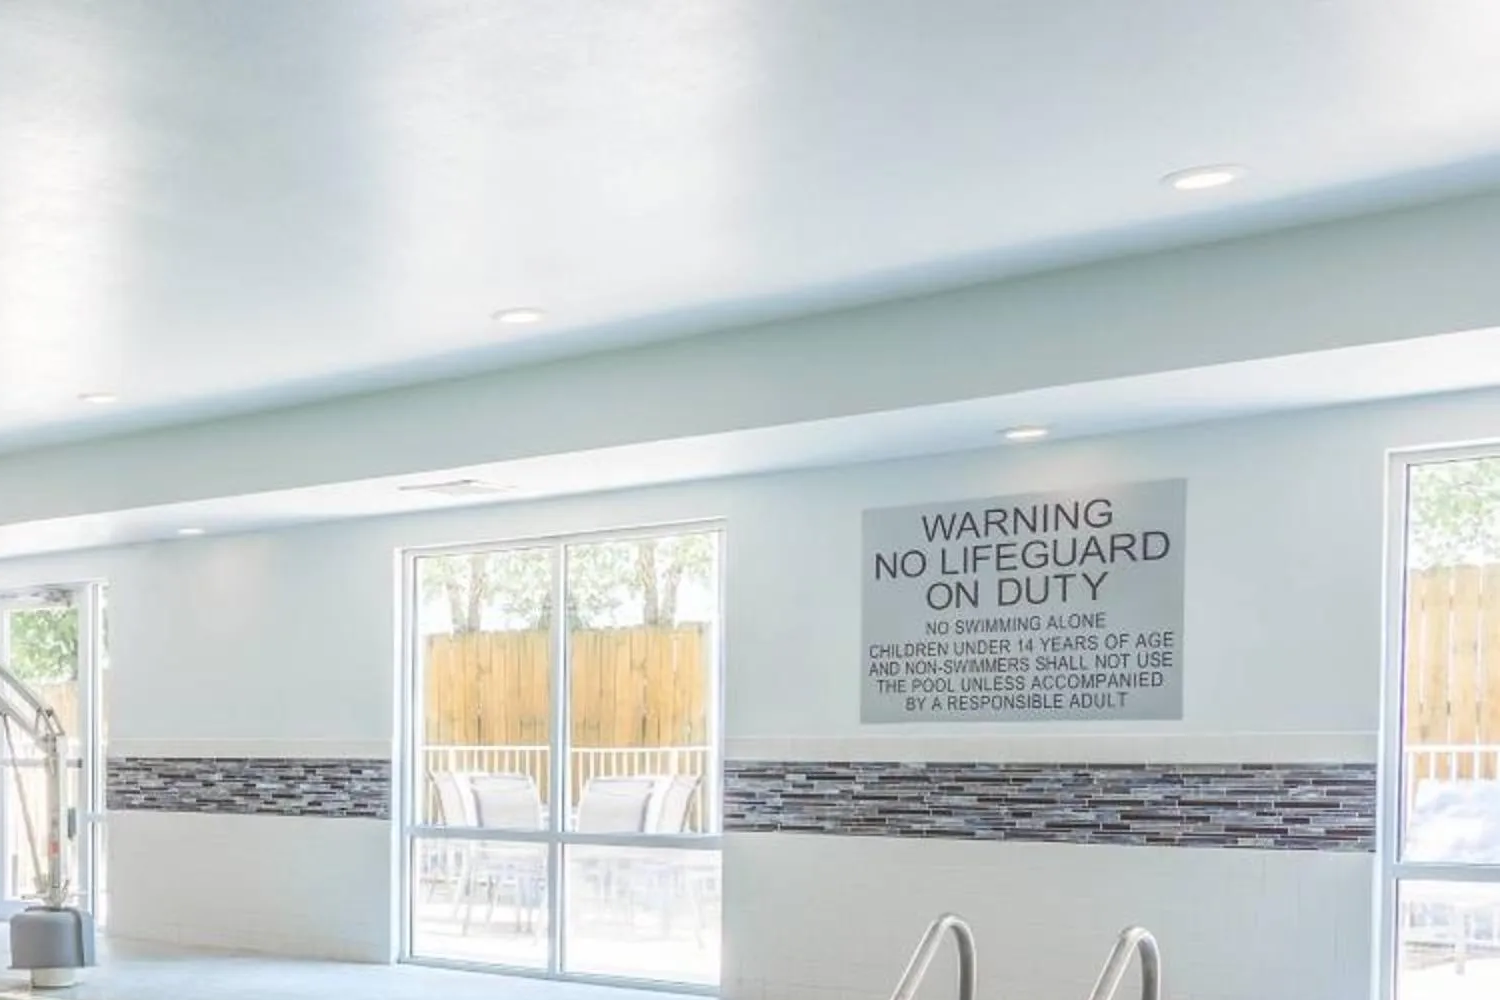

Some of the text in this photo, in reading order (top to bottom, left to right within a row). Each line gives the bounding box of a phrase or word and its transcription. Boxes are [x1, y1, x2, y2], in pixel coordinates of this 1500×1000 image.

[922, 499, 1112, 542] WARNING
[875, 530, 1170, 580] NO LIFEGUARD
[926, 571, 1109, 610] ON DUTY
[925, 612, 1107, 636] NO SWIMMING ALONE
[869, 631, 1174, 660] CHILDREN UNDER 14 YEARS OF AGE
[869, 651, 1173, 677] AND NON-SWIMMERS SHALL NOT USE
[876, 671, 1163, 694] THE POOL UNLESS ACCOMPANIED
[904, 692, 1128, 712] BY A RESPONSIBLE ADULT
